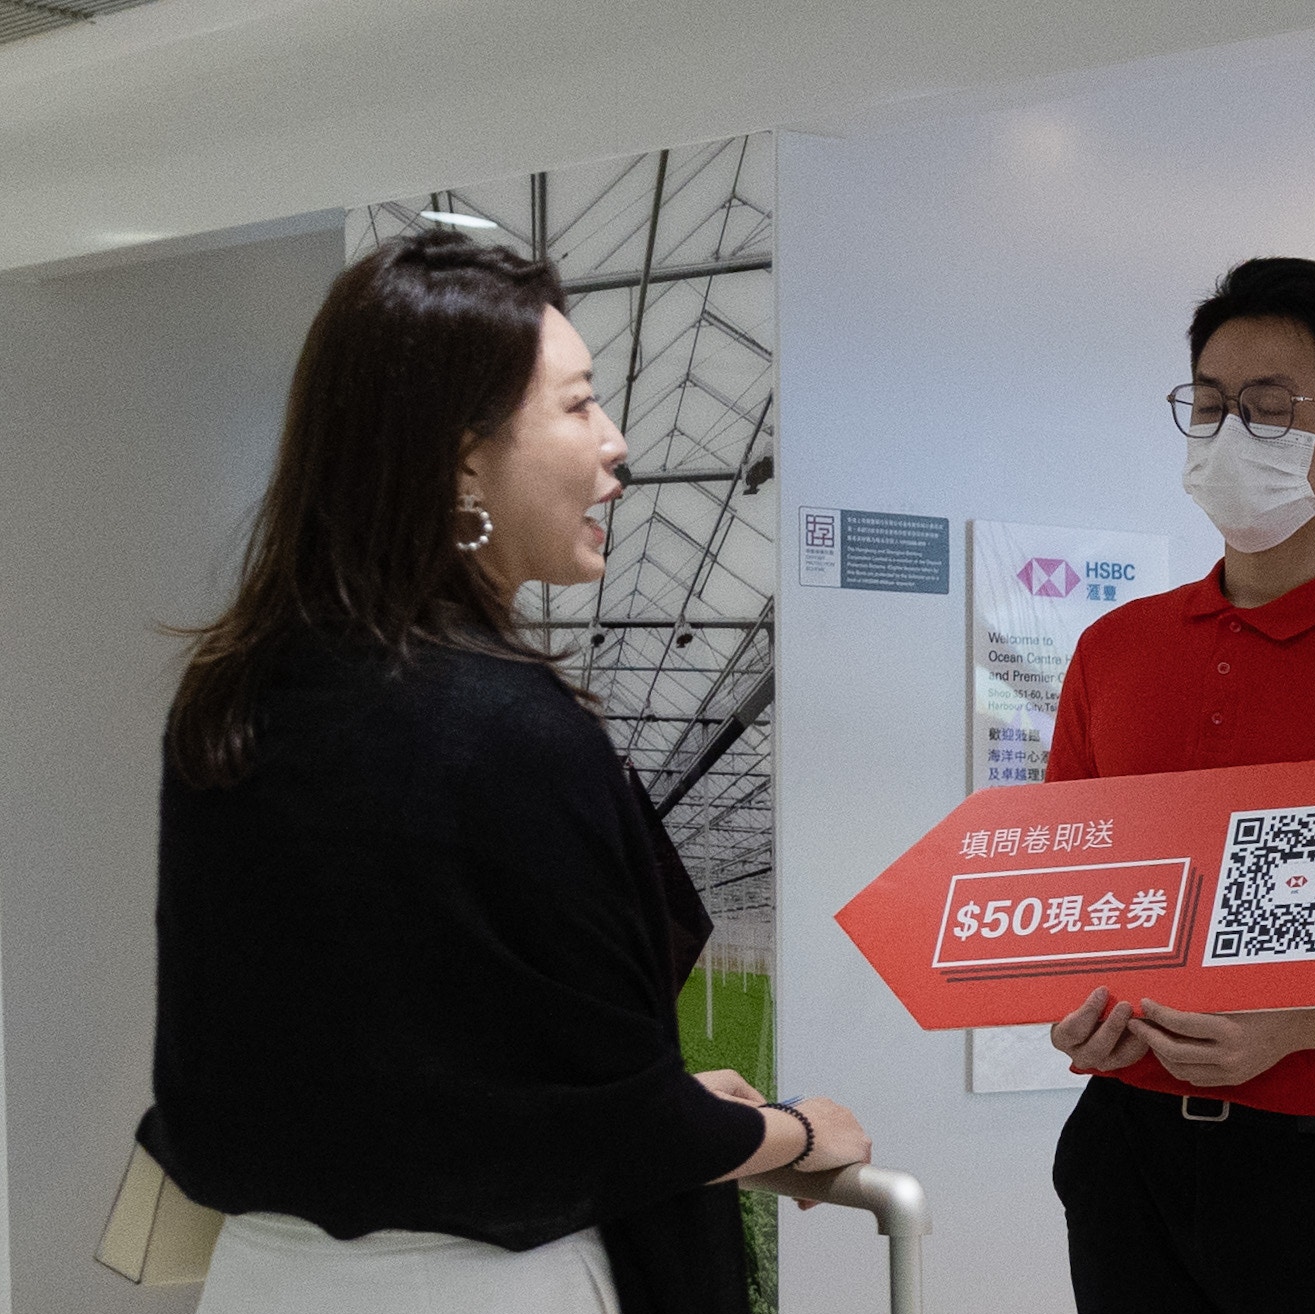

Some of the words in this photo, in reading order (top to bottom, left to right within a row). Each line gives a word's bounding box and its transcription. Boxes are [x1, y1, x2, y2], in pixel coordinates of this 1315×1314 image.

[1086, 561, 1136, 581] HSBC
[987, 632, 1040, 646] Welcome
[1043, 636, 1054, 647] to
[988, 649, 1024, 663] Ocean
[1026, 652, 1062, 665] Centre
[988, 669, 1010, 682] and
[1012, 669, 1056, 683] Premier
[987, 688, 1011, 699] Shop
[987, 700, 1023, 711] Harbour
[958, 818, 1116, 860] 填問卷即送
[952, 888, 1169, 943] $50現金券
